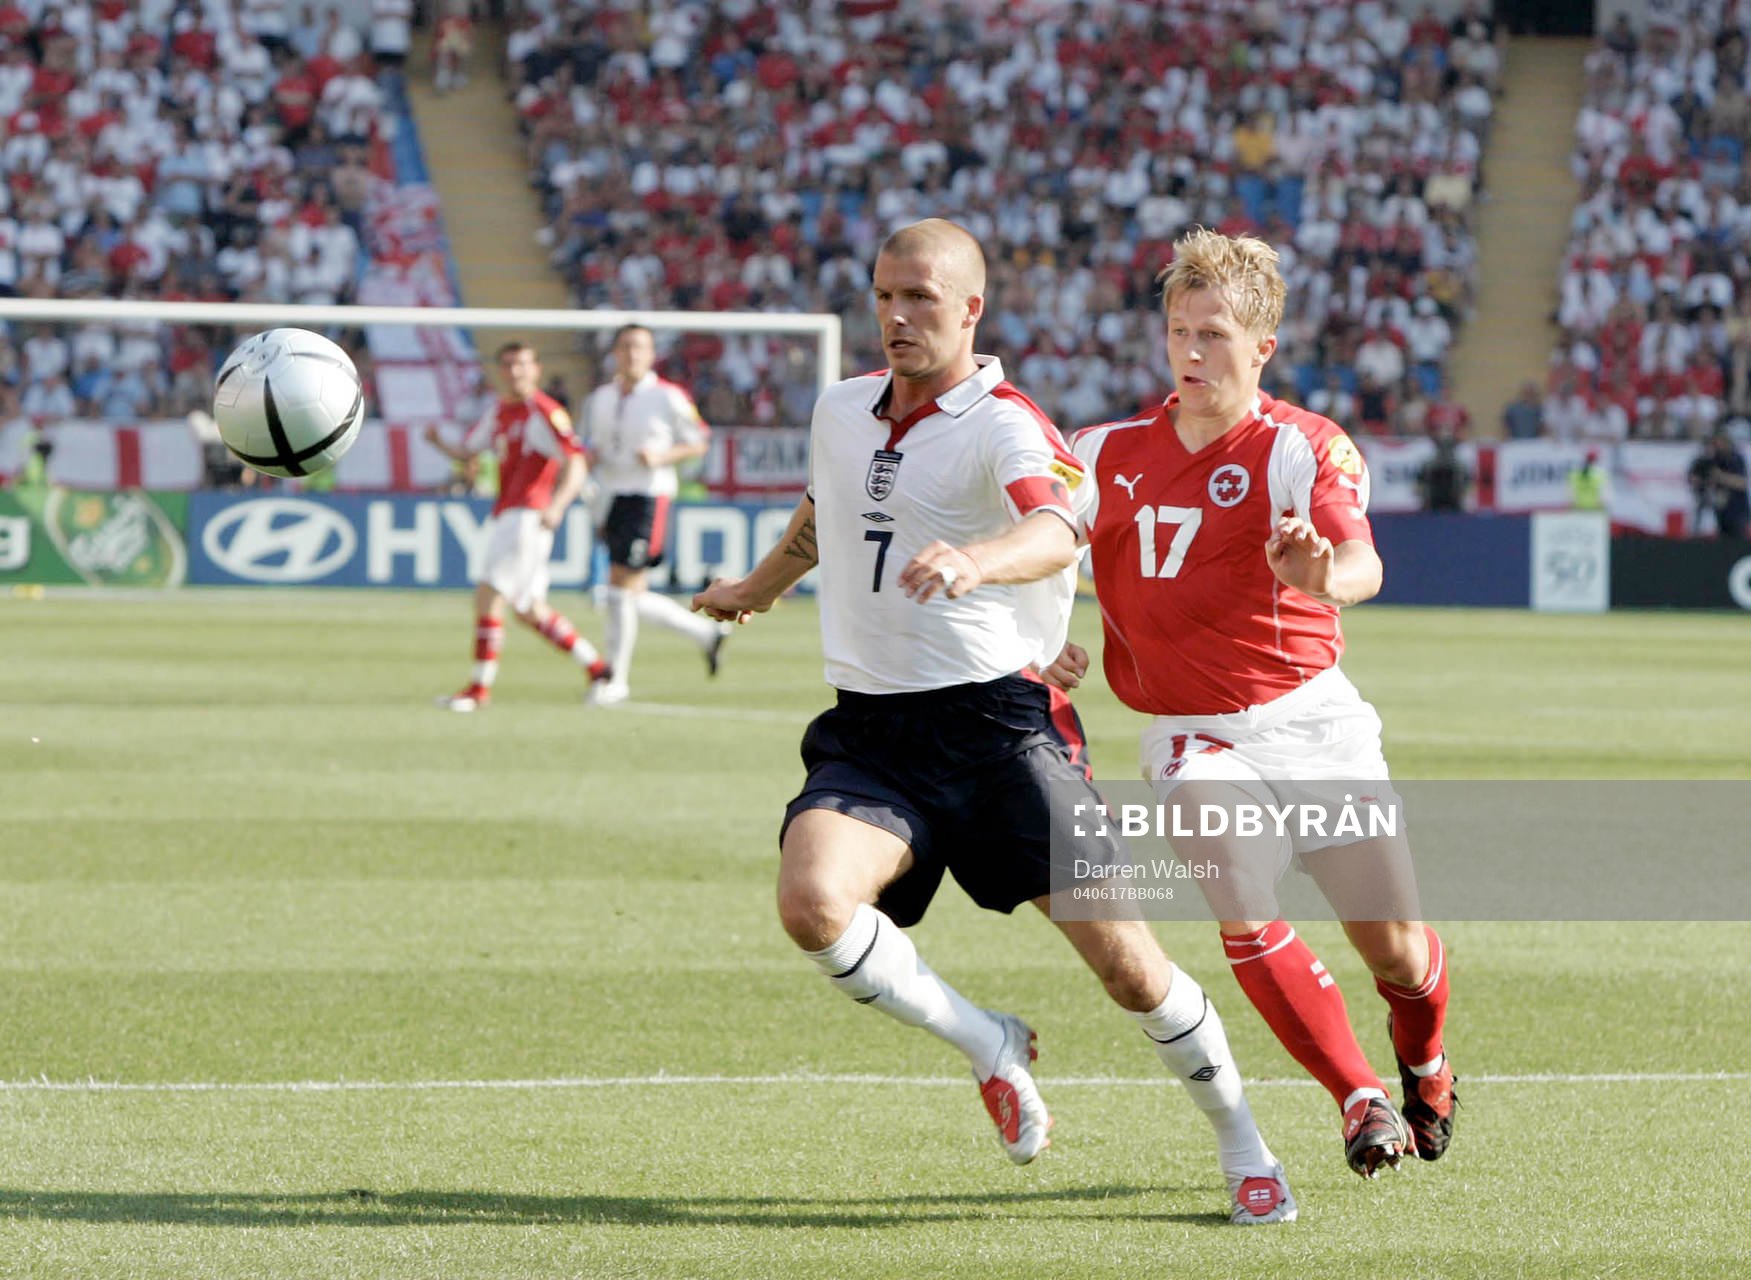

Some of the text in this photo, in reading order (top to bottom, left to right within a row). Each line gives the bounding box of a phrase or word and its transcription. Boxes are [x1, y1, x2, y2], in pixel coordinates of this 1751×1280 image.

[366, 500, 820, 588] HYUD
[864, 530, 894, 592] 7
[1134, 504, 1203, 578] 17
[1170, 733, 1234, 759] 17
